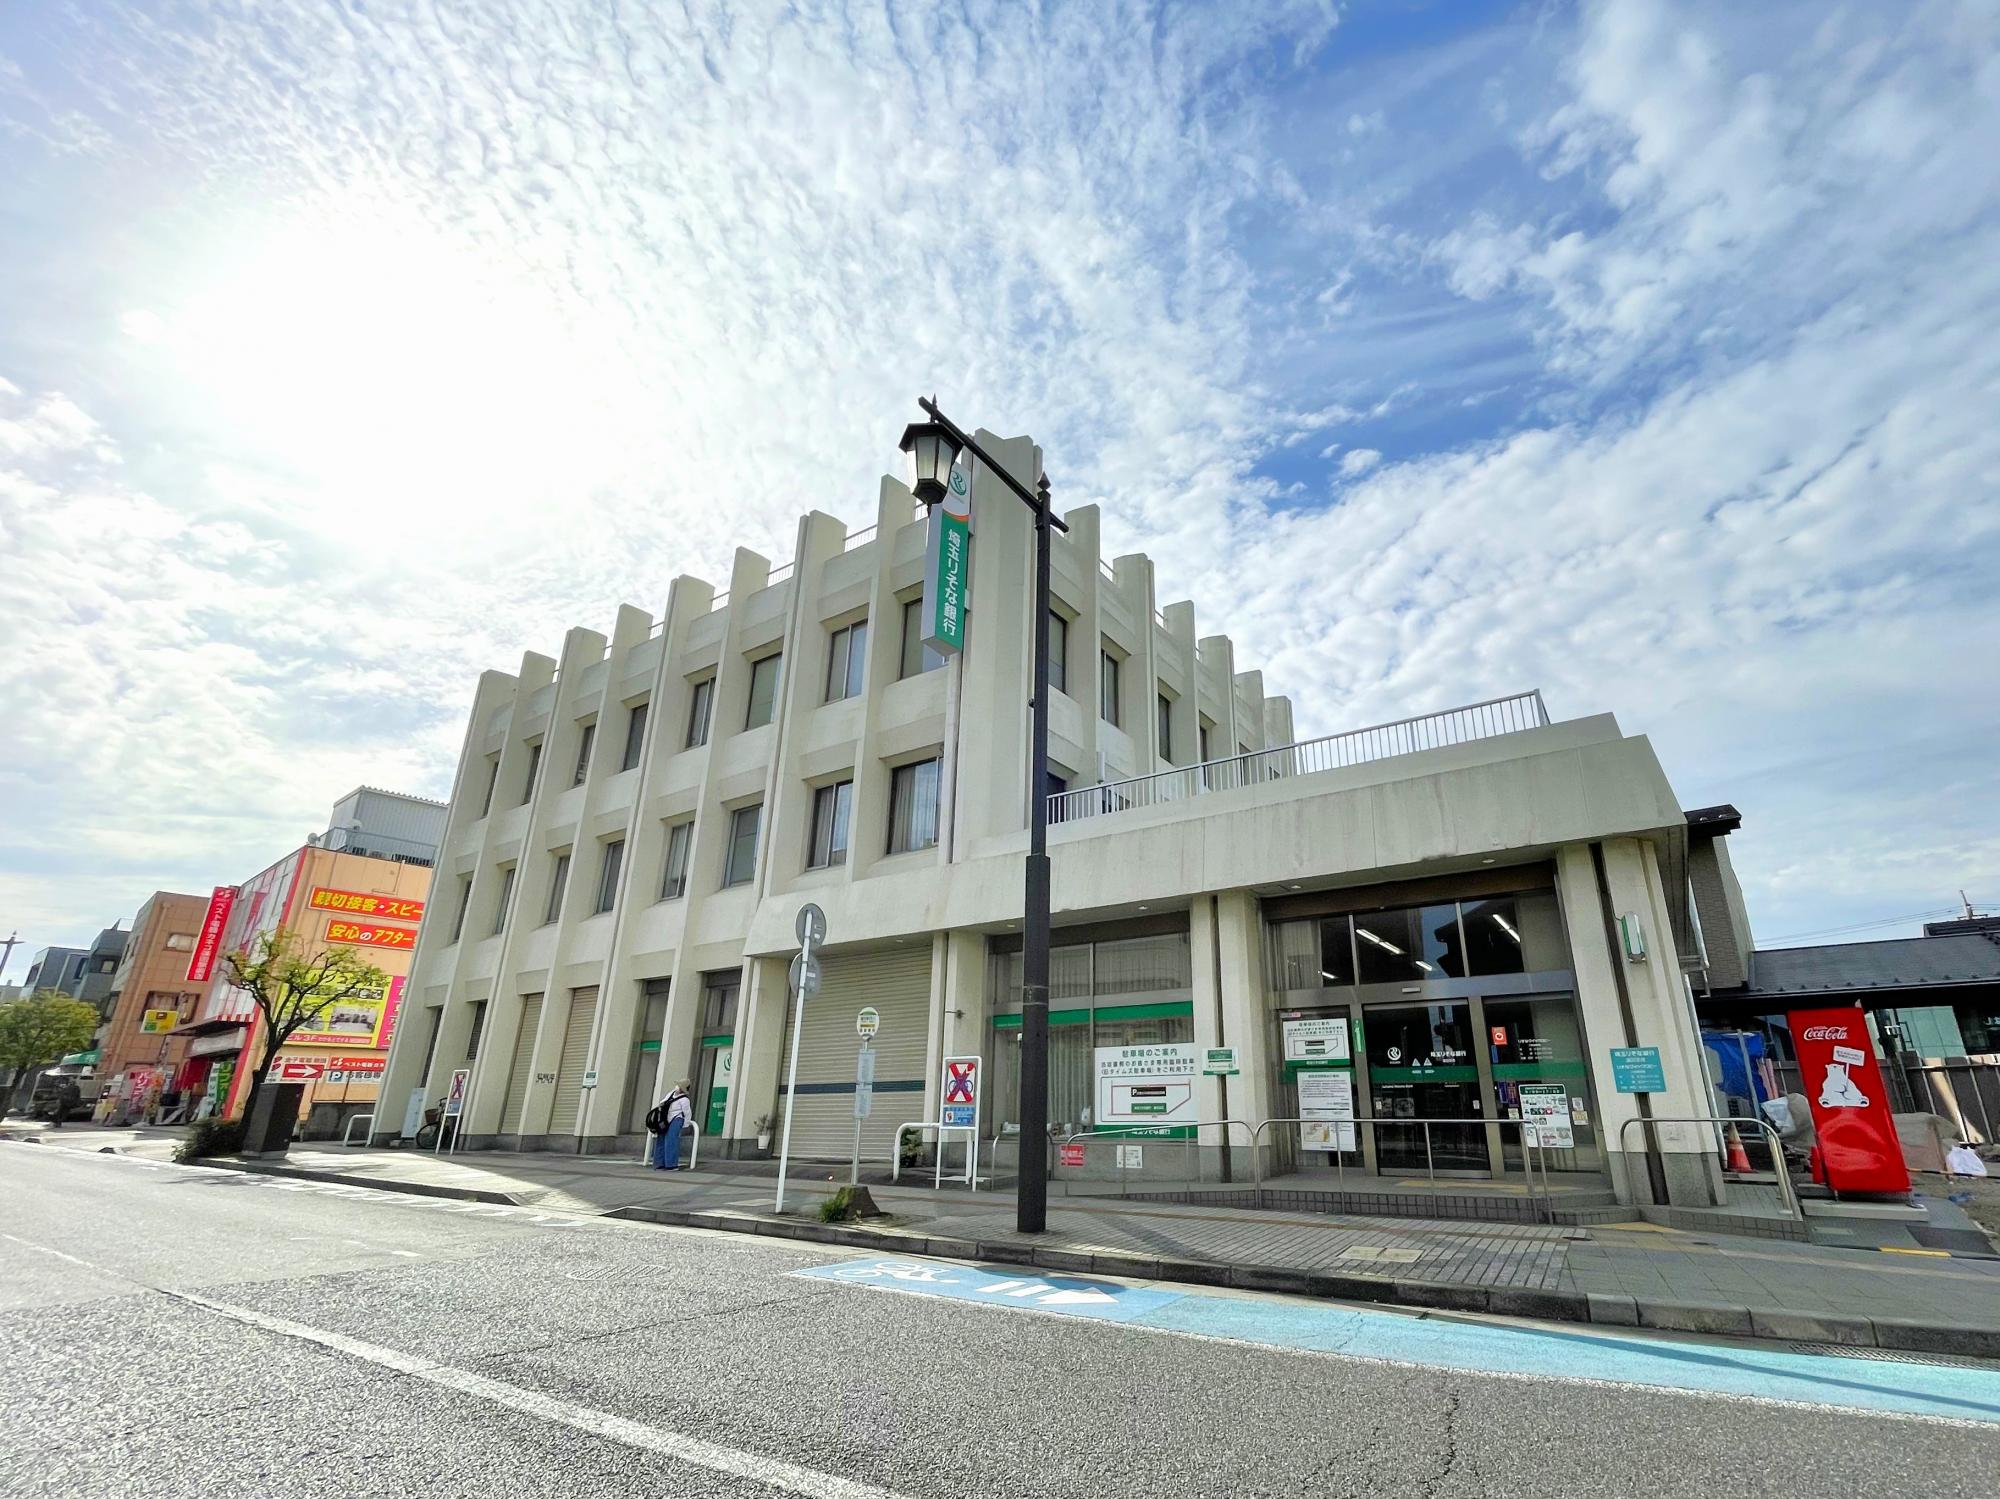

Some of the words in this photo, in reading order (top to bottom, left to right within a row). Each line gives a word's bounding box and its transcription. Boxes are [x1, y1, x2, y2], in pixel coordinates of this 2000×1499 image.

[943, 528, 961, 637] 埼玉りそな銀行
[1803, 1025, 1848, 1040] Coca-Cola
[1122, 1048, 1178, 1058] 駐車場のご案内
